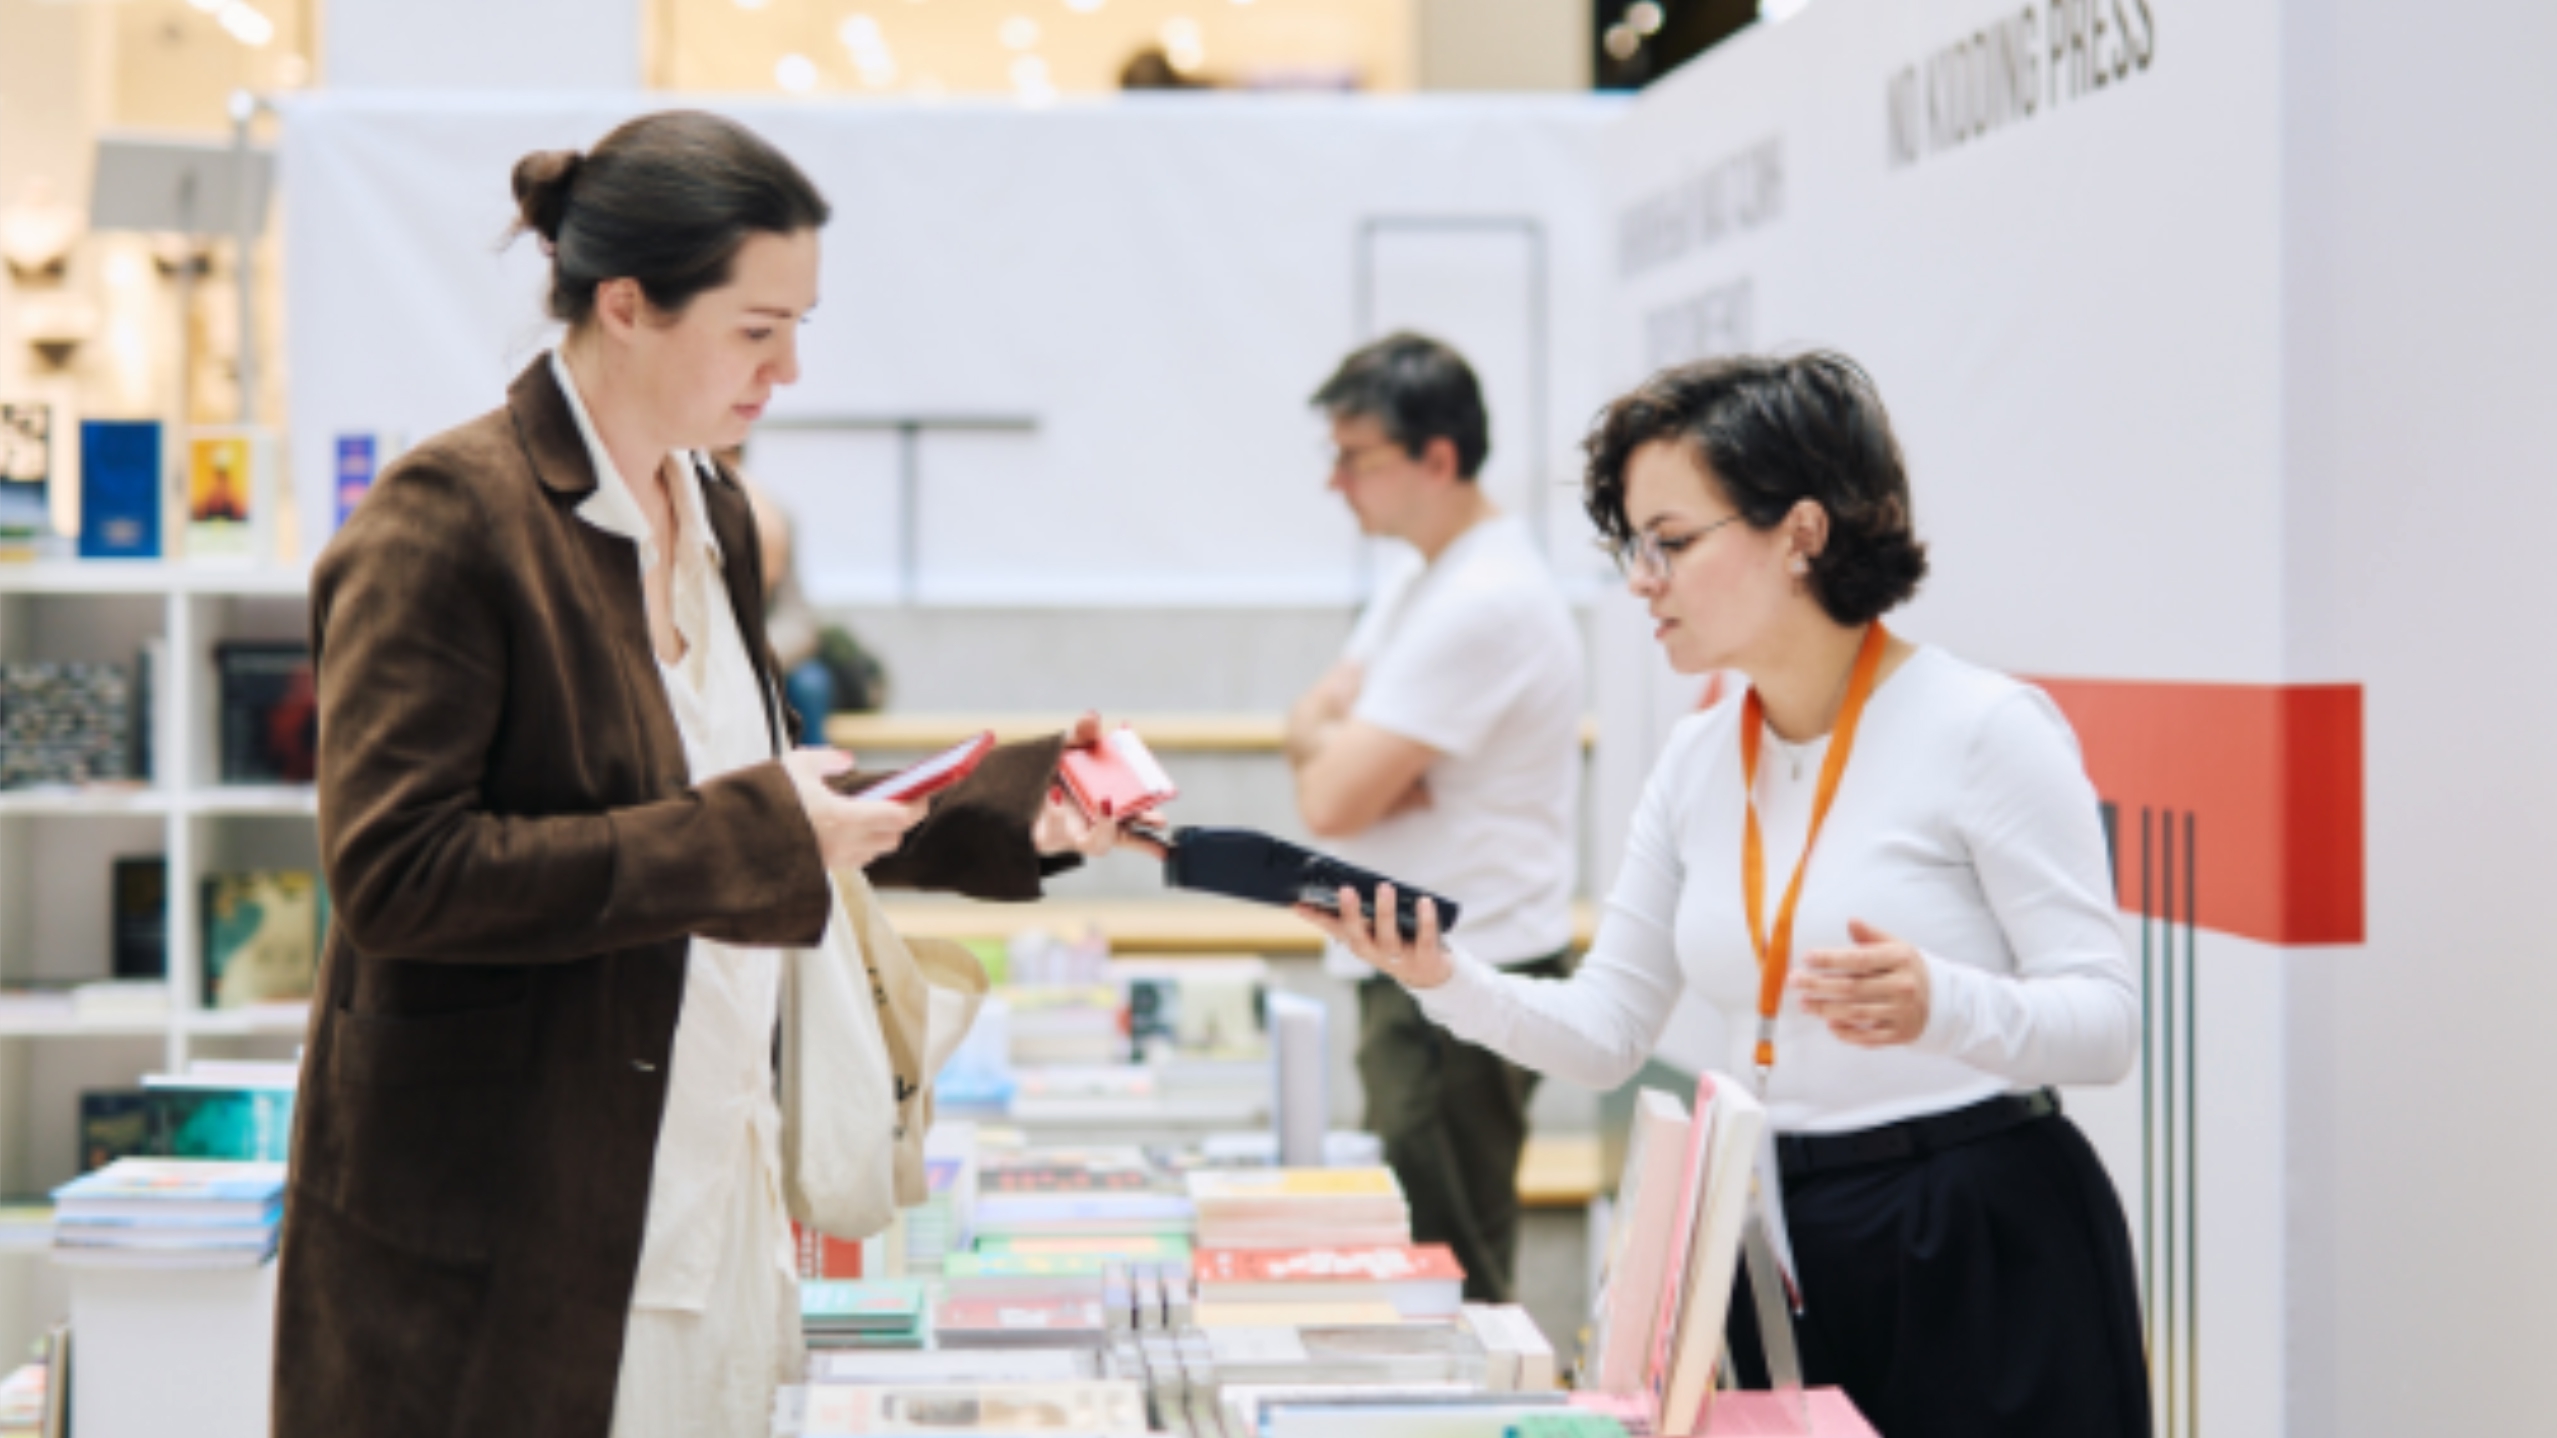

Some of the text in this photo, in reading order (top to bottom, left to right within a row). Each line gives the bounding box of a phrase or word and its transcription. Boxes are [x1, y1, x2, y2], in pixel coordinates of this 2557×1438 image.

[1886, 0, 2155, 168] NO KIDDING PRESS
